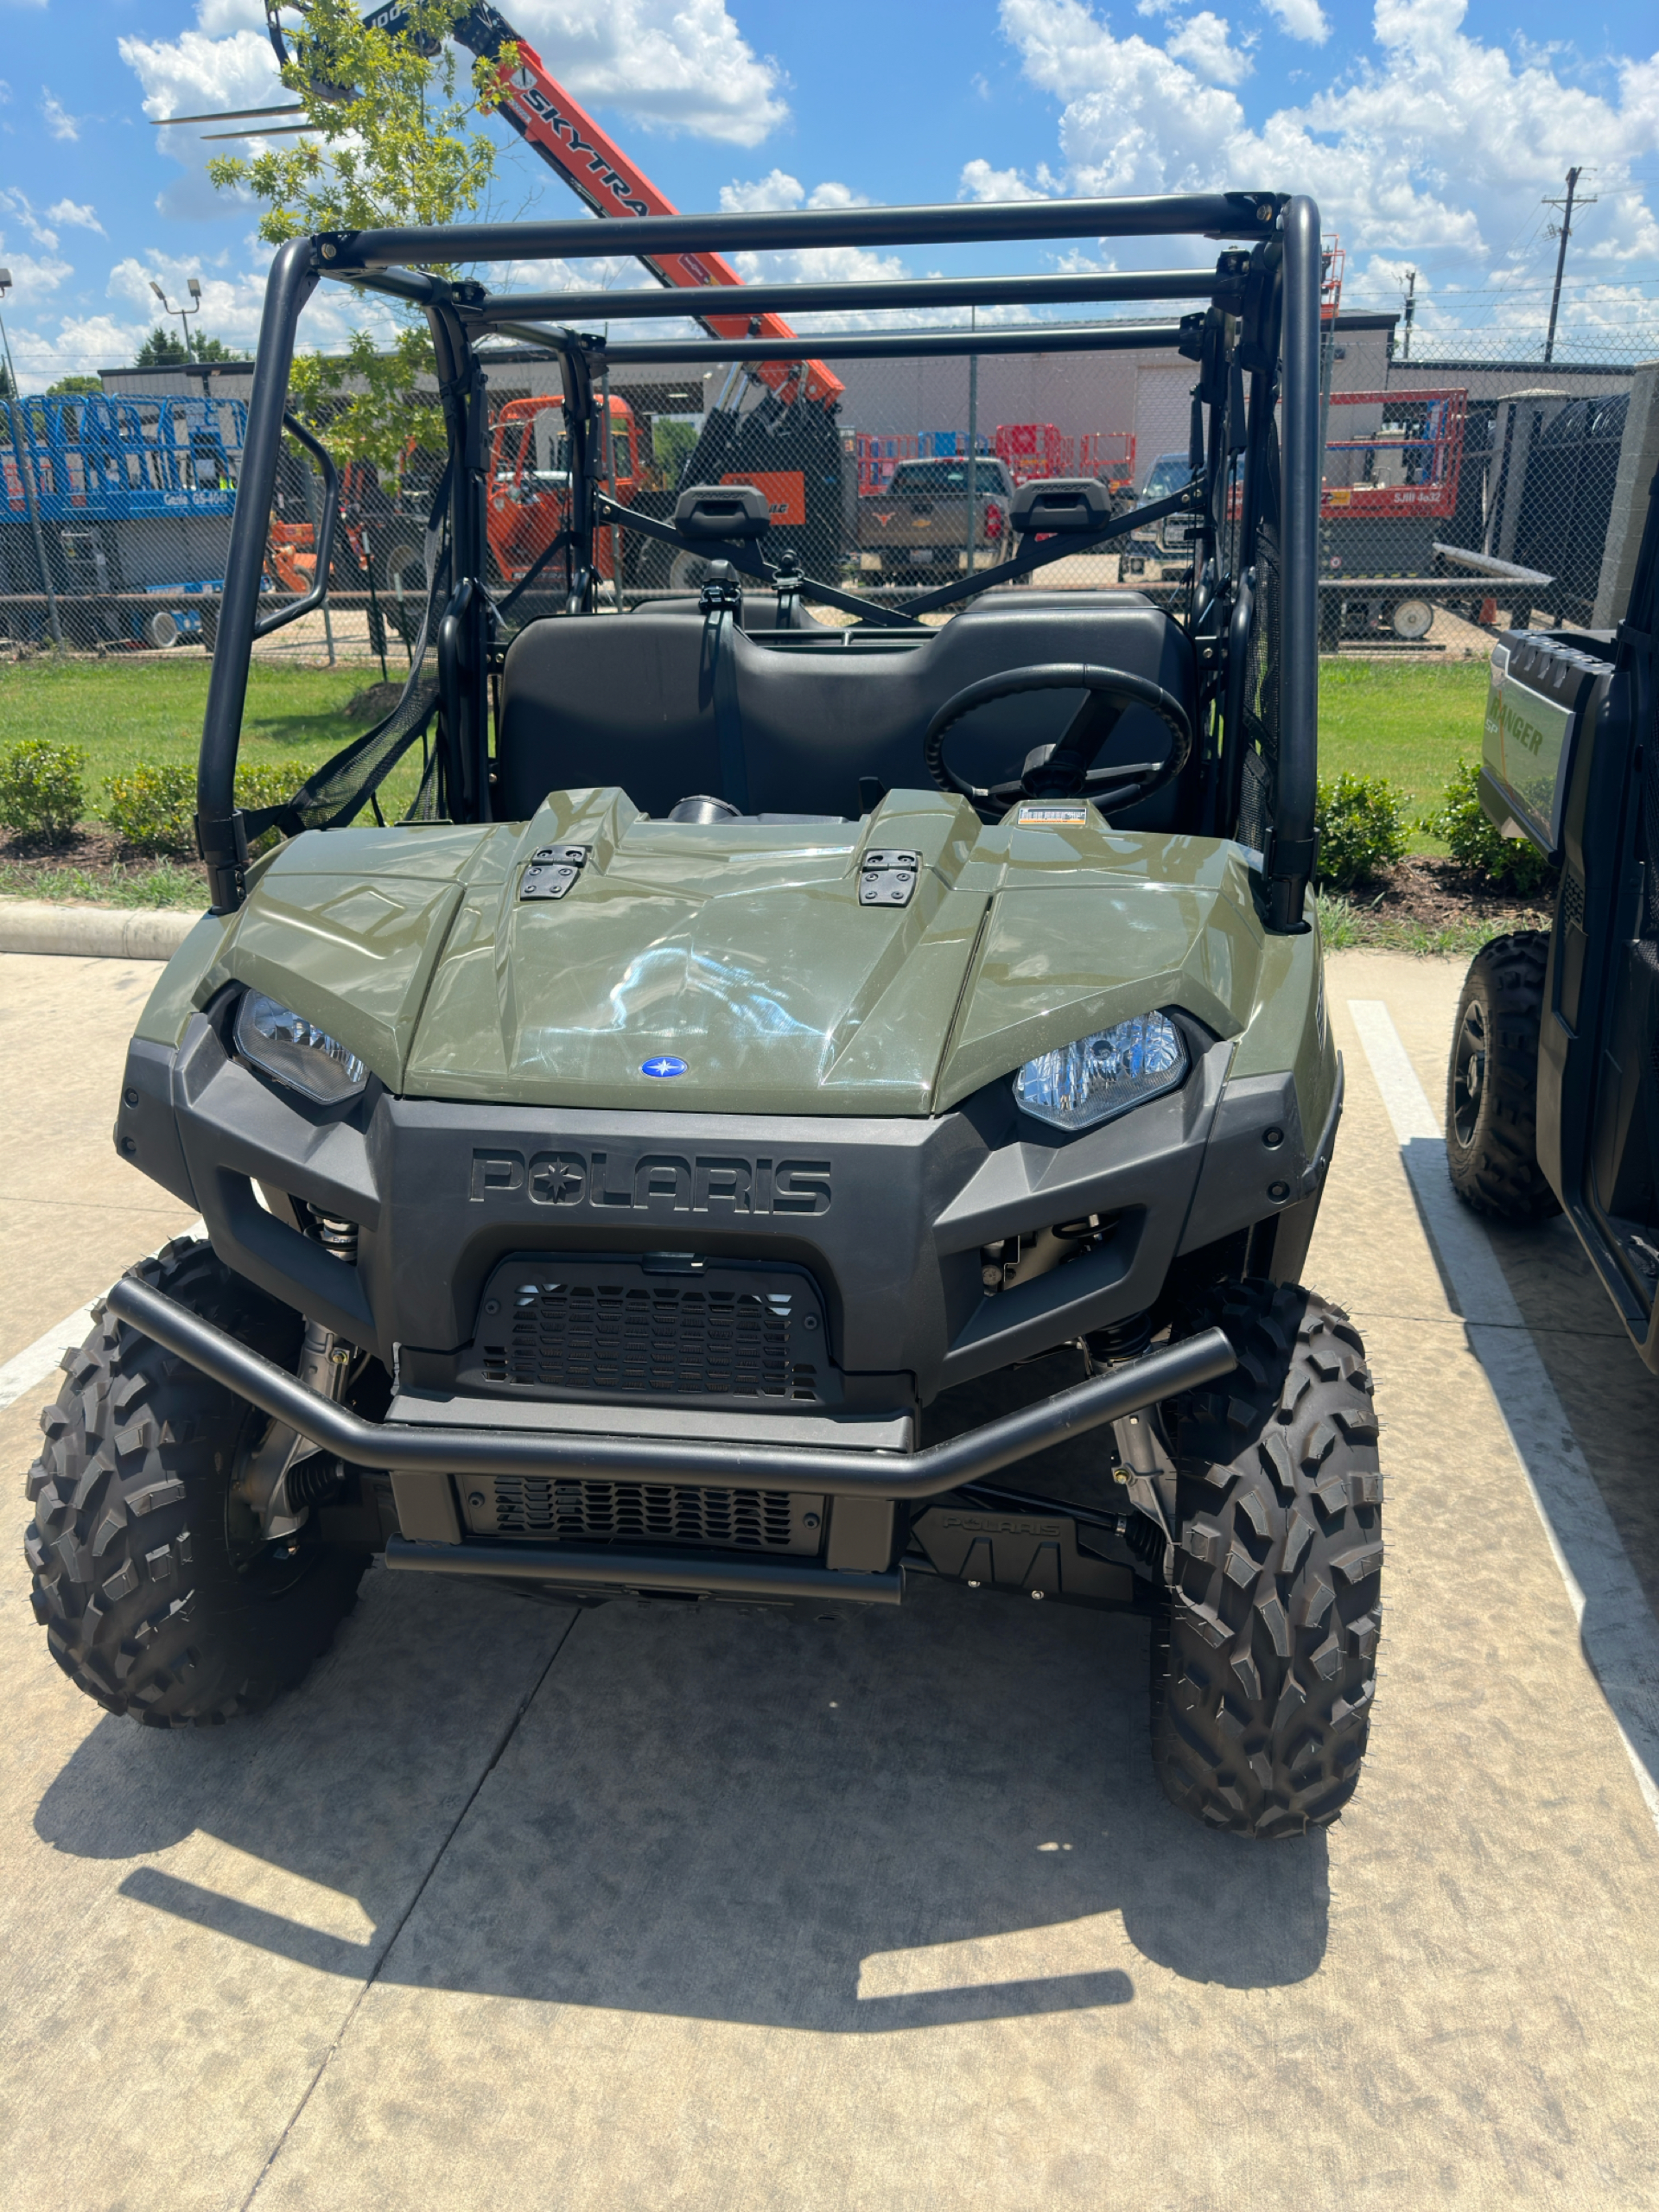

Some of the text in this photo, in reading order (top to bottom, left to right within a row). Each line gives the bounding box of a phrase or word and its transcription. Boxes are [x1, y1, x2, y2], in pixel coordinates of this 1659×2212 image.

[520, 88, 649, 217] SKYTRA
[1490, 696, 1543, 757] RANGER
[469, 1147, 832, 1217] POLARIS
[944, 1516, 1060, 1536] POLARIS
